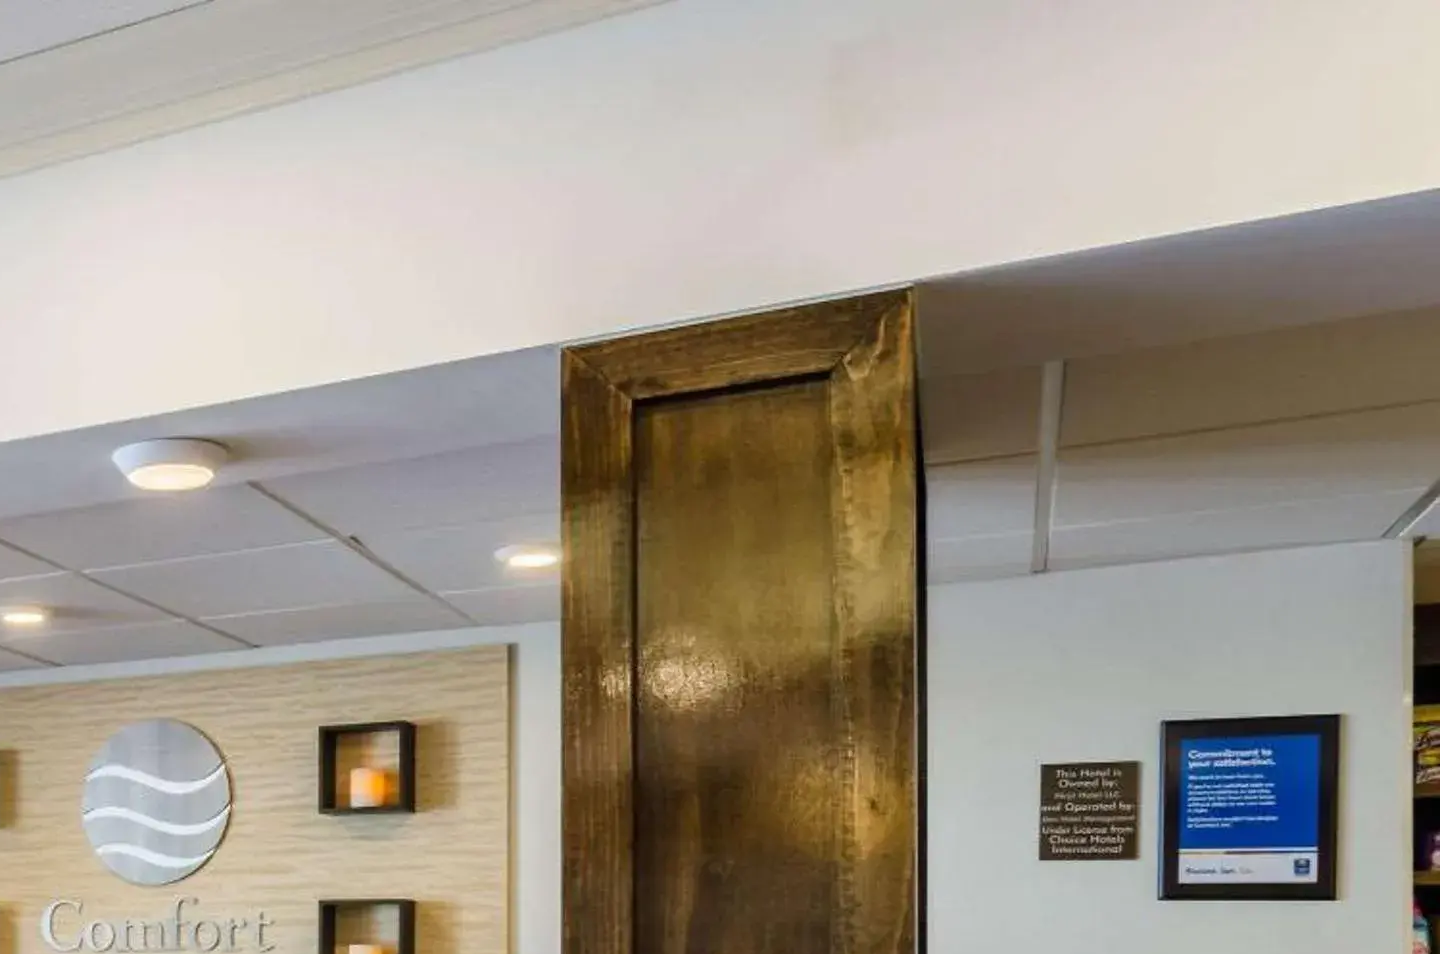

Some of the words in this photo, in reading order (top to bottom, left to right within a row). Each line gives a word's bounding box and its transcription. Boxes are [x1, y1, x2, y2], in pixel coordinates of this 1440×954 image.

[1187, 760, 1210, 769] your
[1055, 768, 1077, 779] This
[1080, 768, 1111, 778] Hotel
[1058, 778, 1099, 789] Owned
[1064, 801, 1117, 813] Operated
[1042, 825, 1071, 835] Under
[1049, 834, 1087, 845] Choice
[1089, 834, 1125, 845] Hotels
[1051, 844, 1123, 855] International
[40, 896, 276, 953] Comfort
